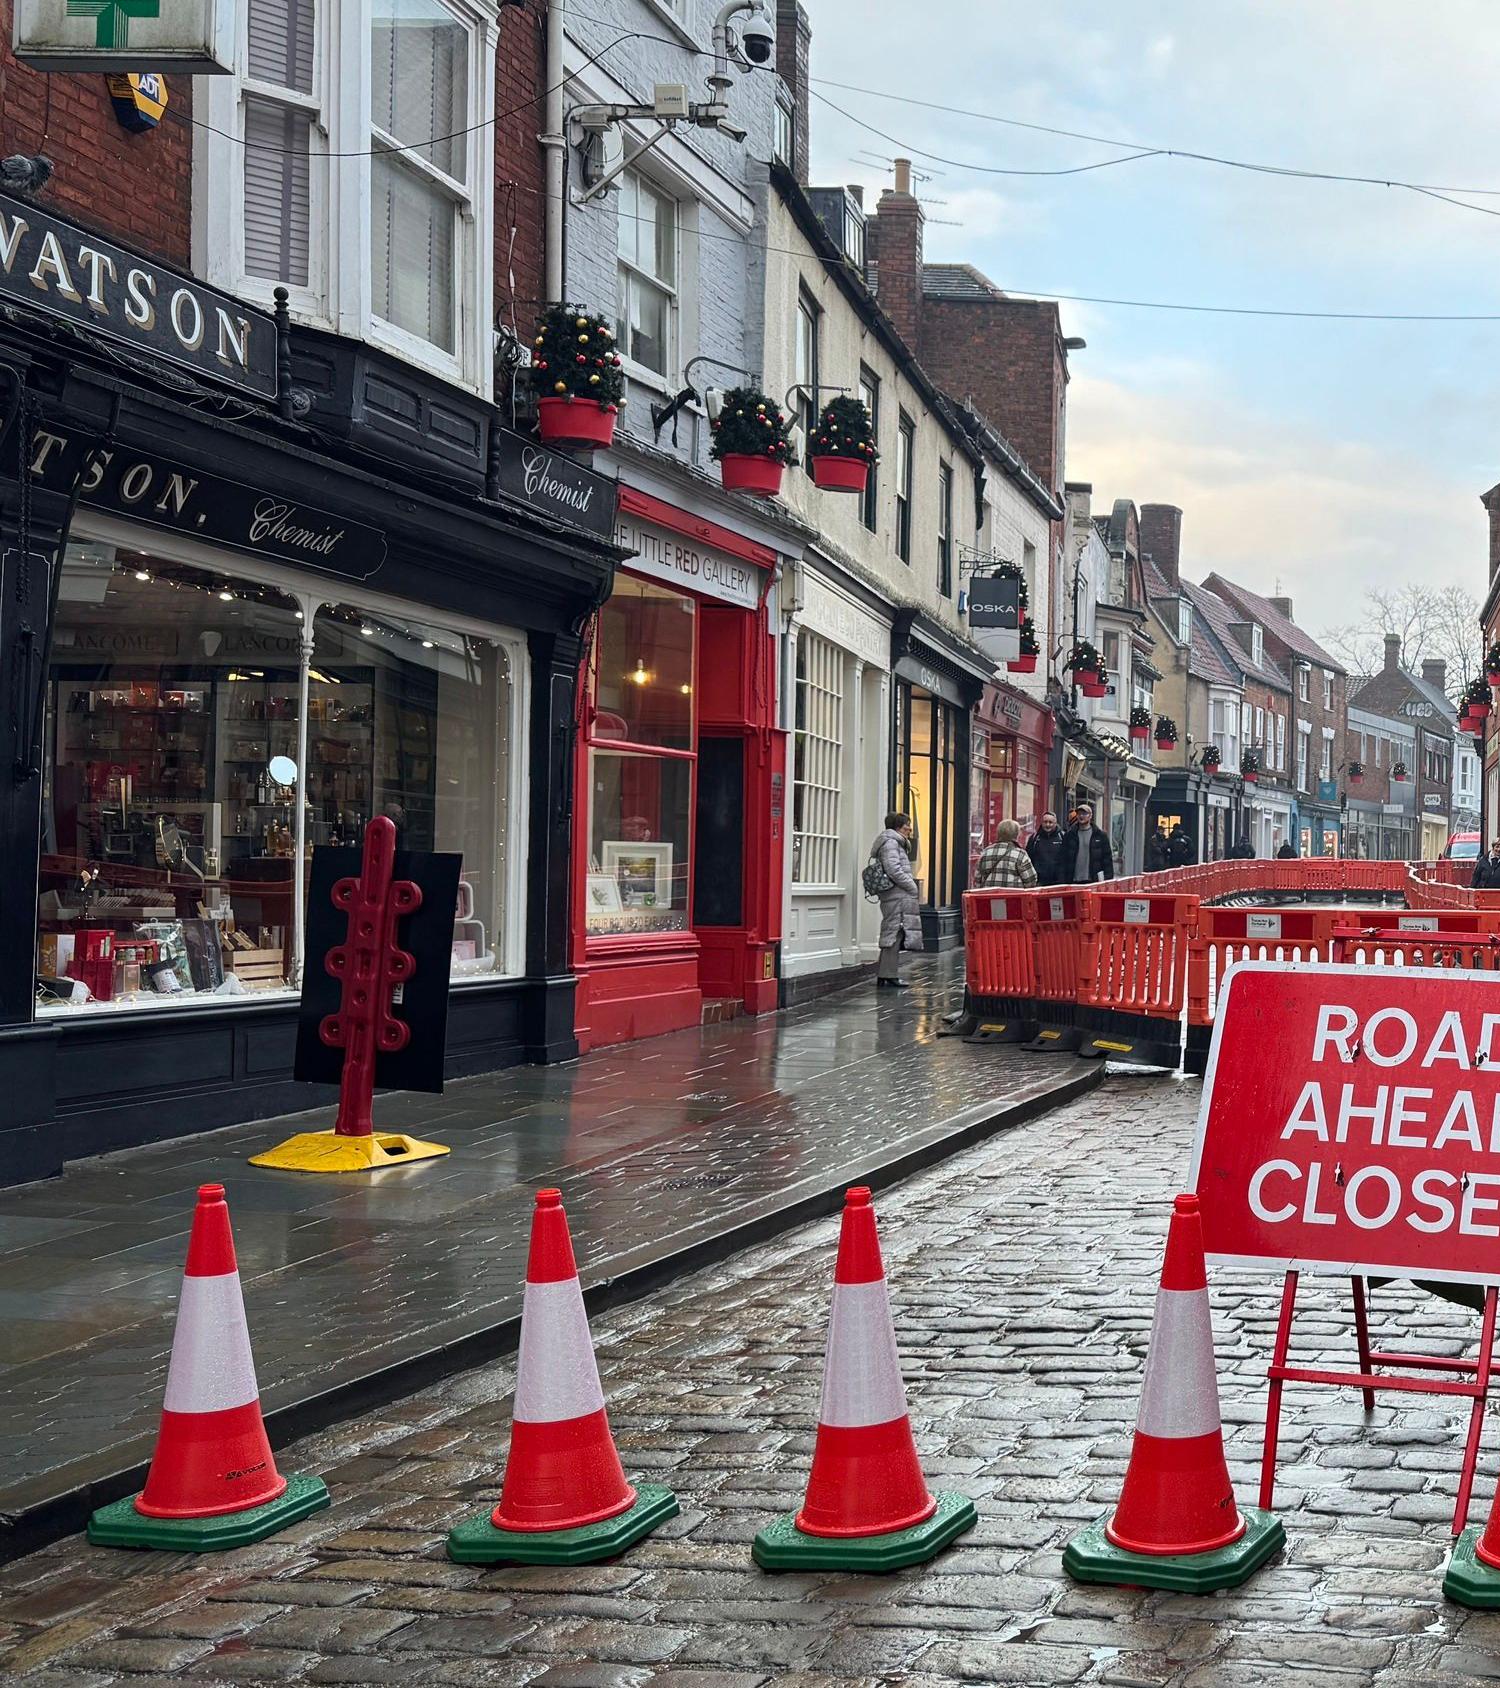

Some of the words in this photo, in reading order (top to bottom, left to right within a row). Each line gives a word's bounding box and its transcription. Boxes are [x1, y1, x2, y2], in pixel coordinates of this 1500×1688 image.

[139, 73, 160, 98] ADT
[0, 418, 207, 526] TSON.
[249, 497, 344, 556] Chemist
[521, 446, 594, 513] Chemist
[675, 546, 700, 576] RED
[702, 557, 751, 594] GALLERY
[972, 603, 1015, 613] OSKA
[919, 667, 943, 695] OSKA
